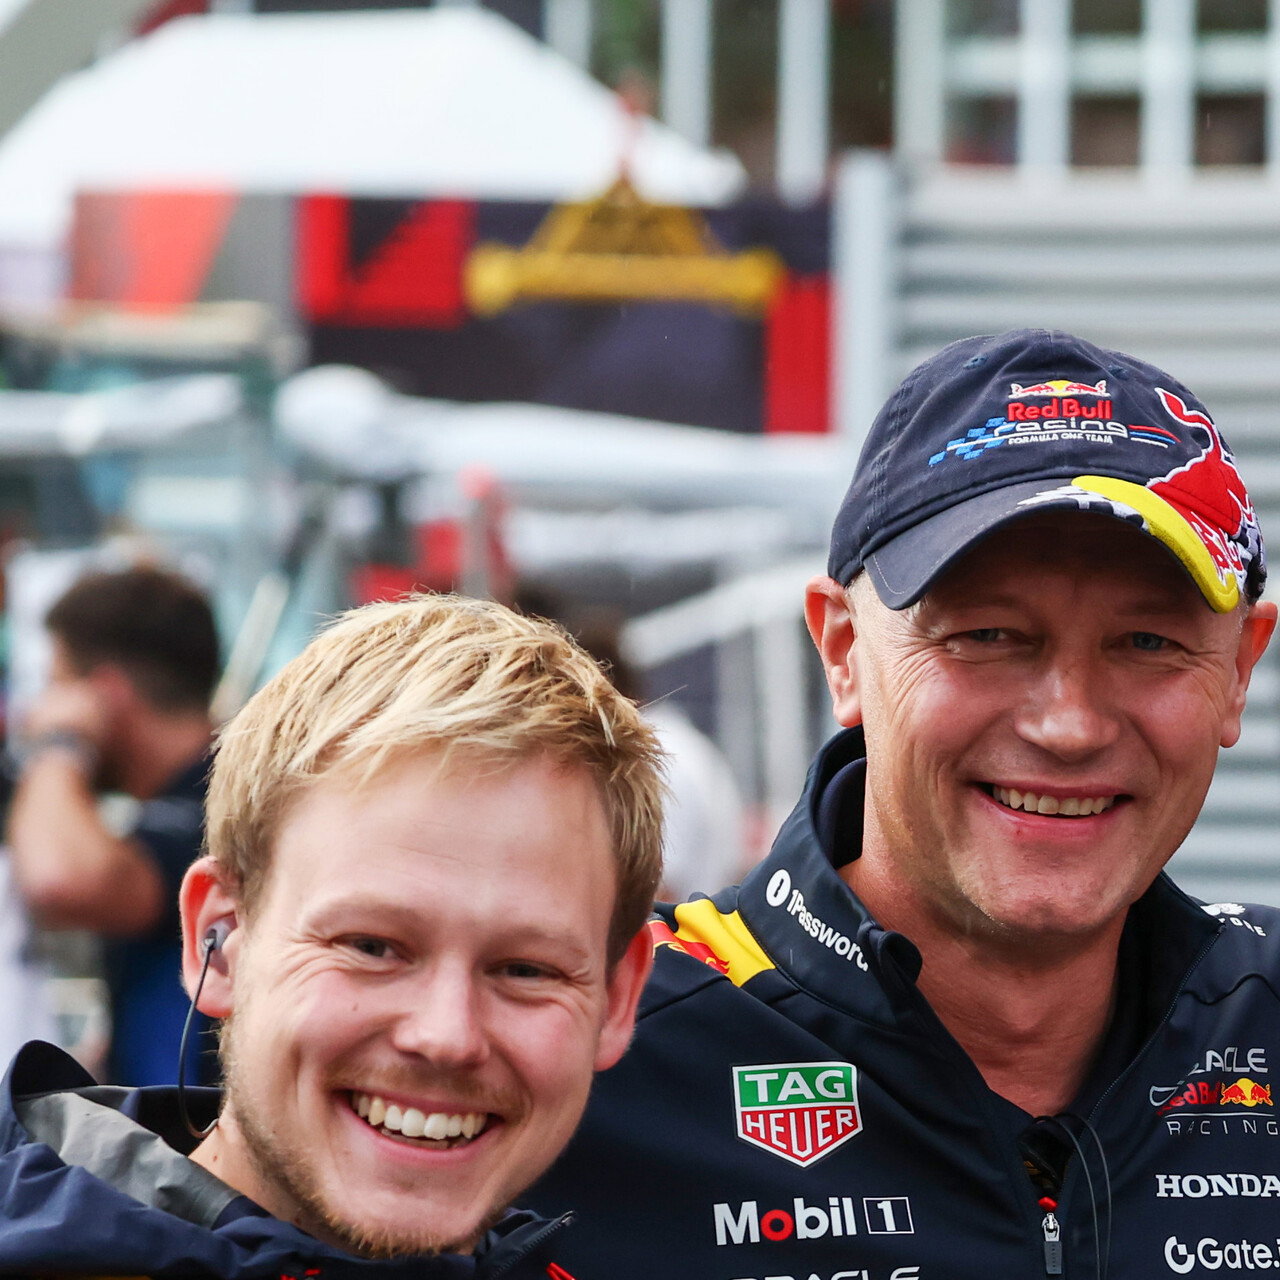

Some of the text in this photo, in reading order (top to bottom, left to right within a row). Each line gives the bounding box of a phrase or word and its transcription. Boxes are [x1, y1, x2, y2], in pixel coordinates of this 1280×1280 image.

[1008, 397, 1113, 421] Red Bull
[994, 417, 1128, 439] racing
[1008, 431, 1114, 445] FORMULA ONE TEAM
[744, 1070, 846, 1103] TAG
[745, 1109, 854, 1158] HEUER
[713, 1196, 858, 1246] Mobil
